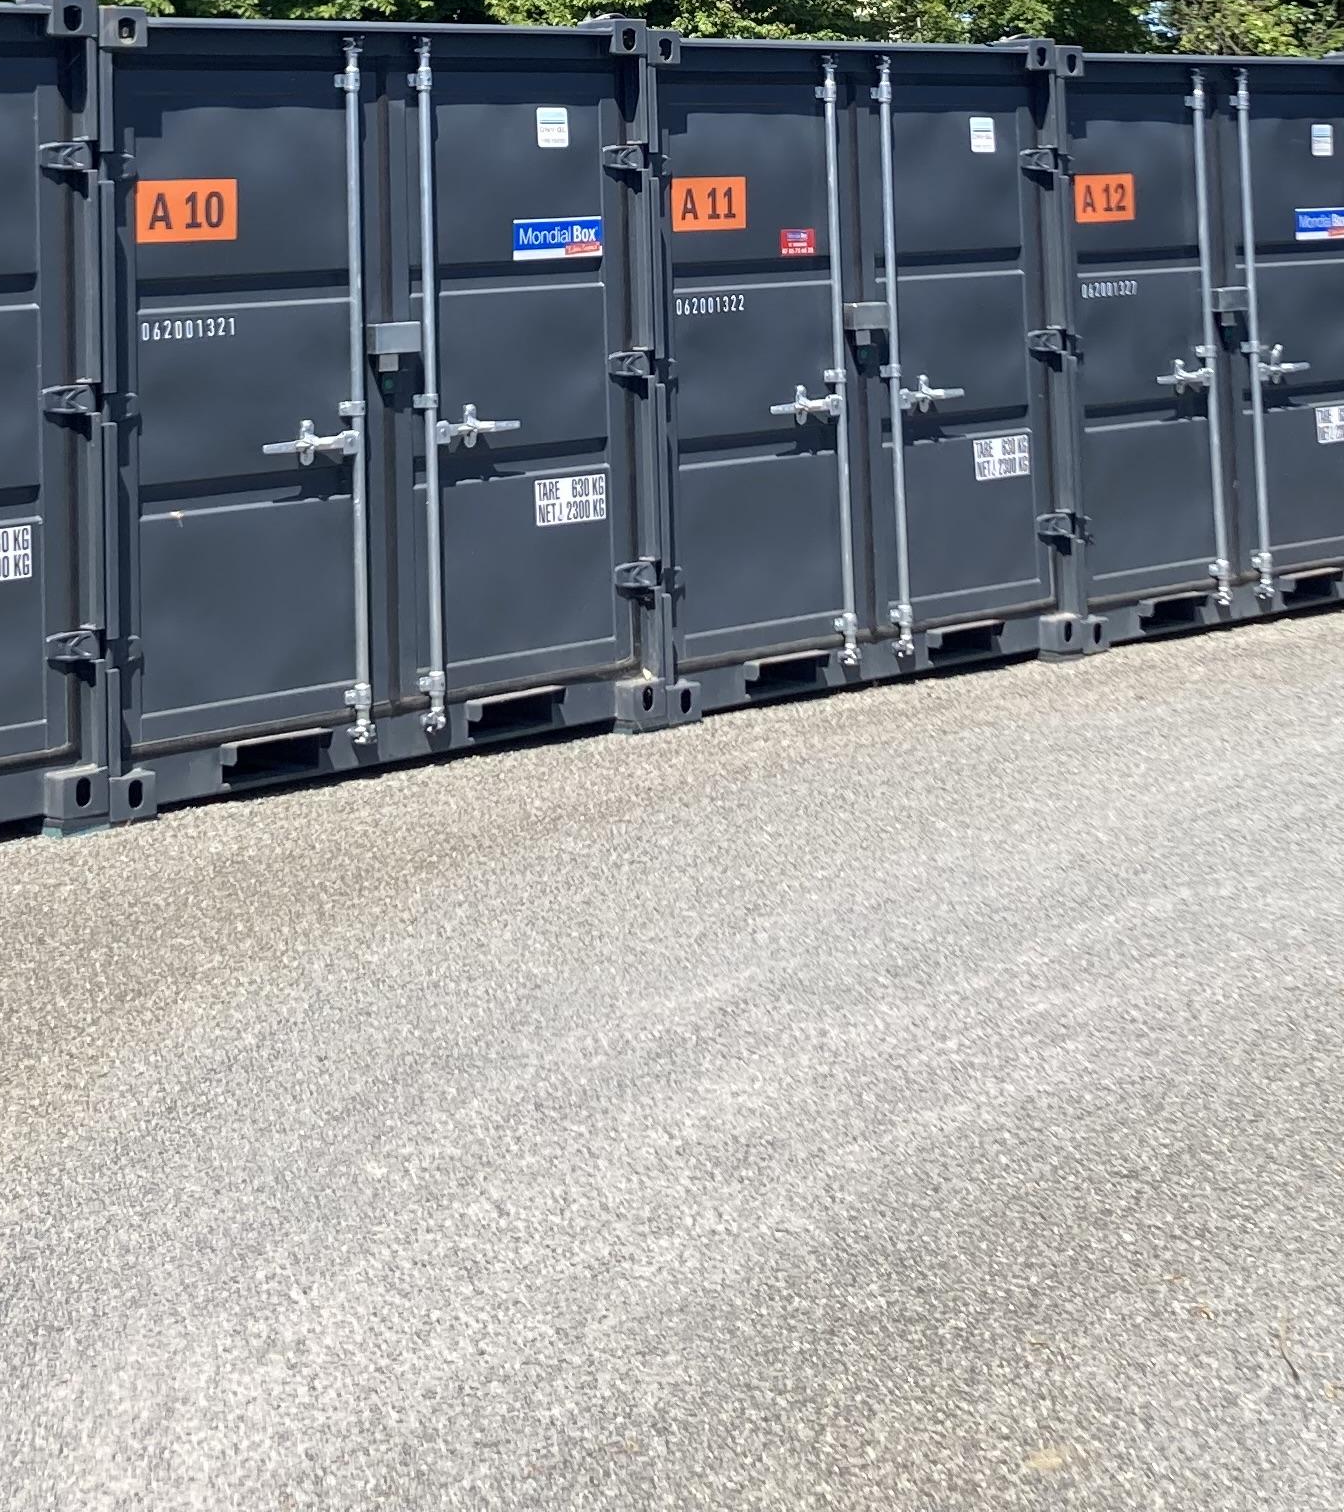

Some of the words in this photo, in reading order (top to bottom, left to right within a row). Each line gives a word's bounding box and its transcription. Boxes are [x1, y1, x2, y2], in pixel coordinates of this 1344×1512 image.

[149, 193, 173, 230] A
[185, 191, 224, 229] 10
[681, 188, 699, 220] A
[707, 187, 736, 219] 11
[1082, 184, 1096, 213] A
[1102, 183, 1127, 212] 12
[676, 294, 745, 315] 062001322
[141, 317, 236, 340] 062001321
[537, 481, 560, 501] TARE
[571, 477, 590, 498] 630
[592, 475, 604, 496] KG
[538, 503, 556, 523] NET
[566, 499, 591, 520] 2300
[592, 498, 605, 518] KG
[13, 527, 29, 552] KG
[13, 553, 30, 577] KG
